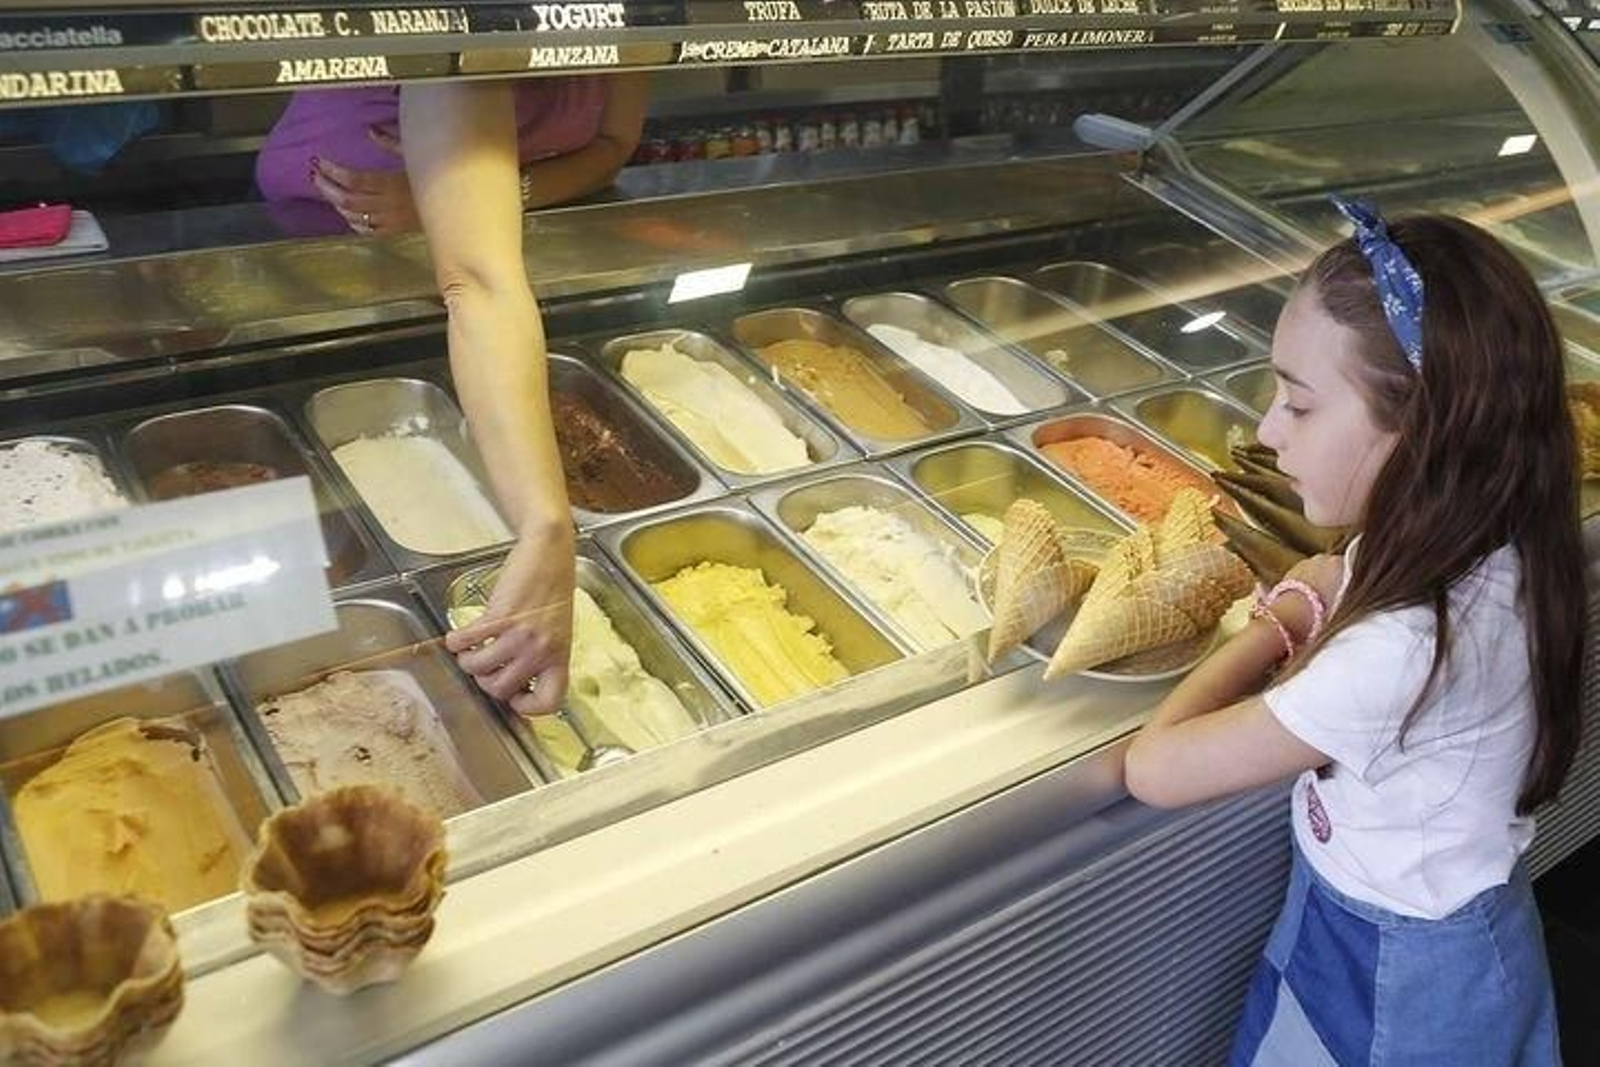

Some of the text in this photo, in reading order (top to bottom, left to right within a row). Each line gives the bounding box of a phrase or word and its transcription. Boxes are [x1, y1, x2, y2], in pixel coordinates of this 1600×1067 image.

[534, 4, 625, 31] YOGURT
[742, 1, 801, 20] TRUFA
[912, 2, 934, 19] DE
[939, 1, 960, 18] LA
[200, 8, 469, 42] CHOCOLATE C. NARANJA
[702, 36, 850, 60] CREMA CATALANA
[886, 32, 934, 50] TARTA
[967, 30, 1014, 49] QUESO
[1023, 31, 1068, 48] PERA
[528, 45, 619, 67] MANZANA
[276, 56, 390, 82] AMARENA
[62, 622, 114, 651] DAN
[122, 616, 140, 635] A
[0, 680, 38, 706] OS
